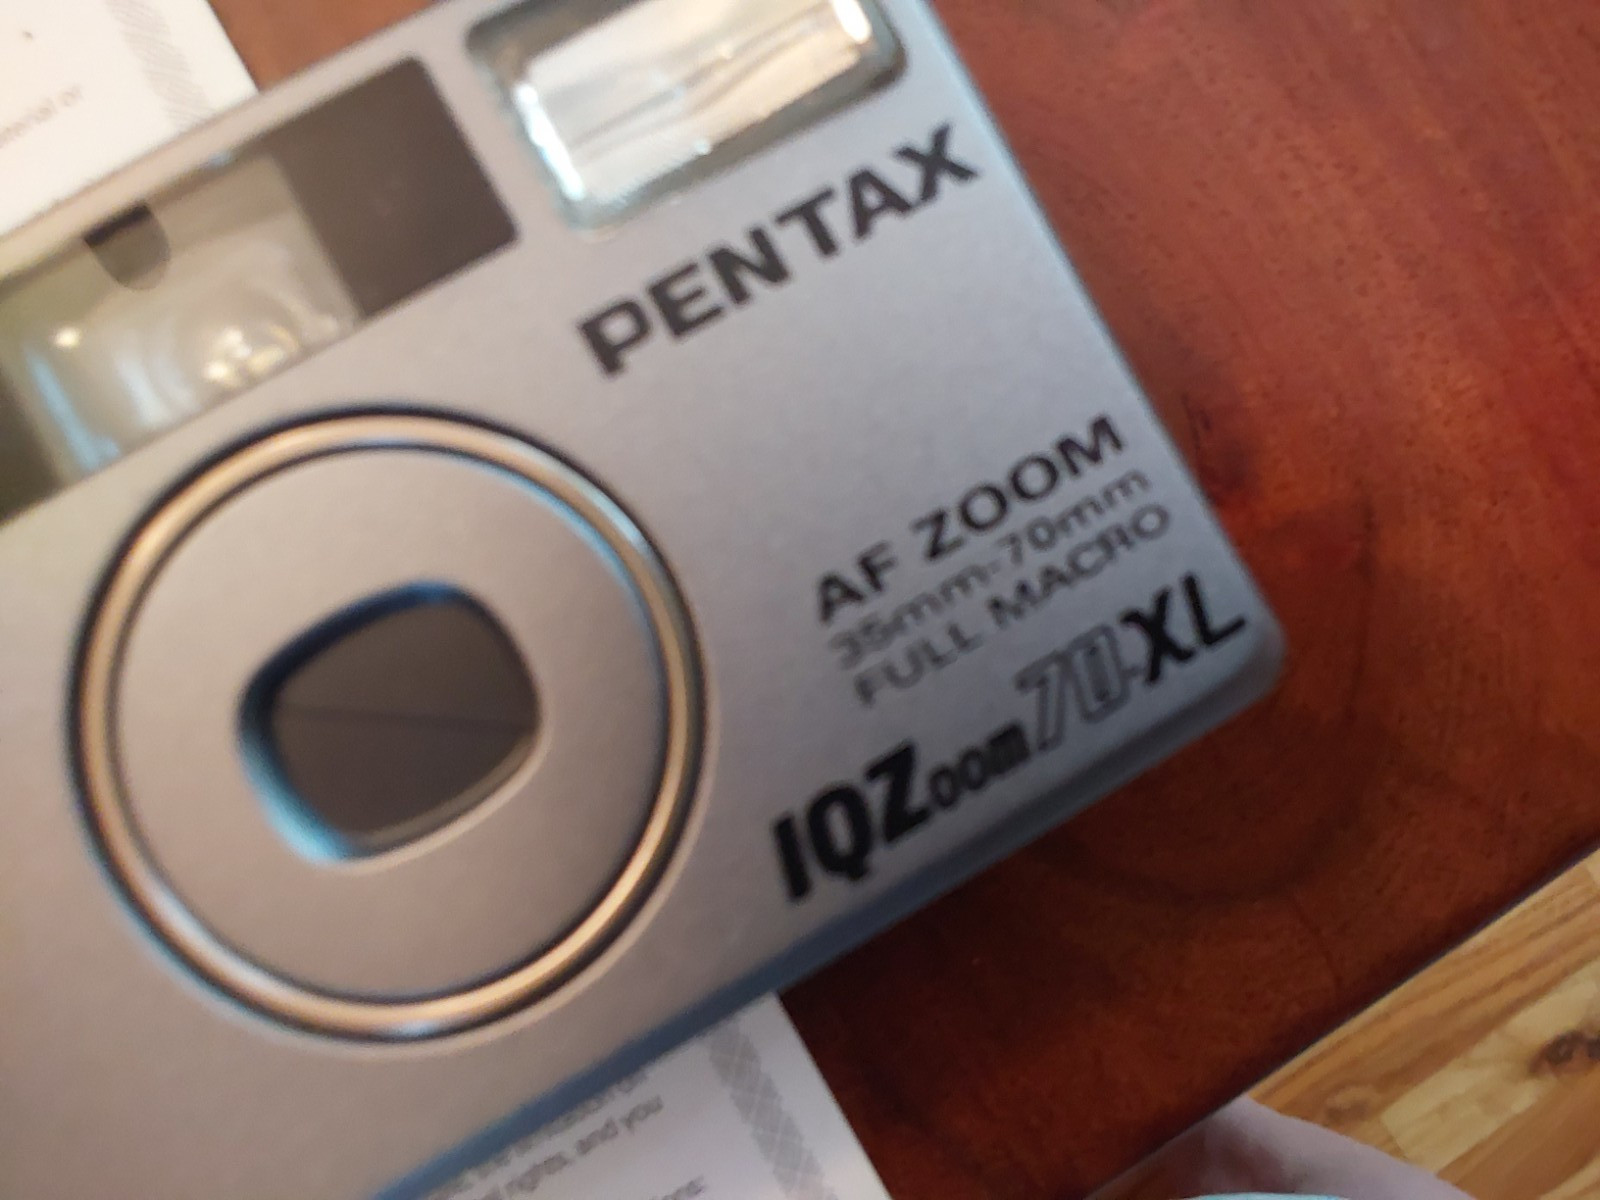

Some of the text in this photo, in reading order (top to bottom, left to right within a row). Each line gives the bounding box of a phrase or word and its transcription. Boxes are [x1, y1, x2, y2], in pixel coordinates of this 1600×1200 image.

[578, 123, 978, 376] PENTAX
[814, 414, 1125, 625] AF ZOOM
[852, 502, 1171, 707] FULL MACRO
